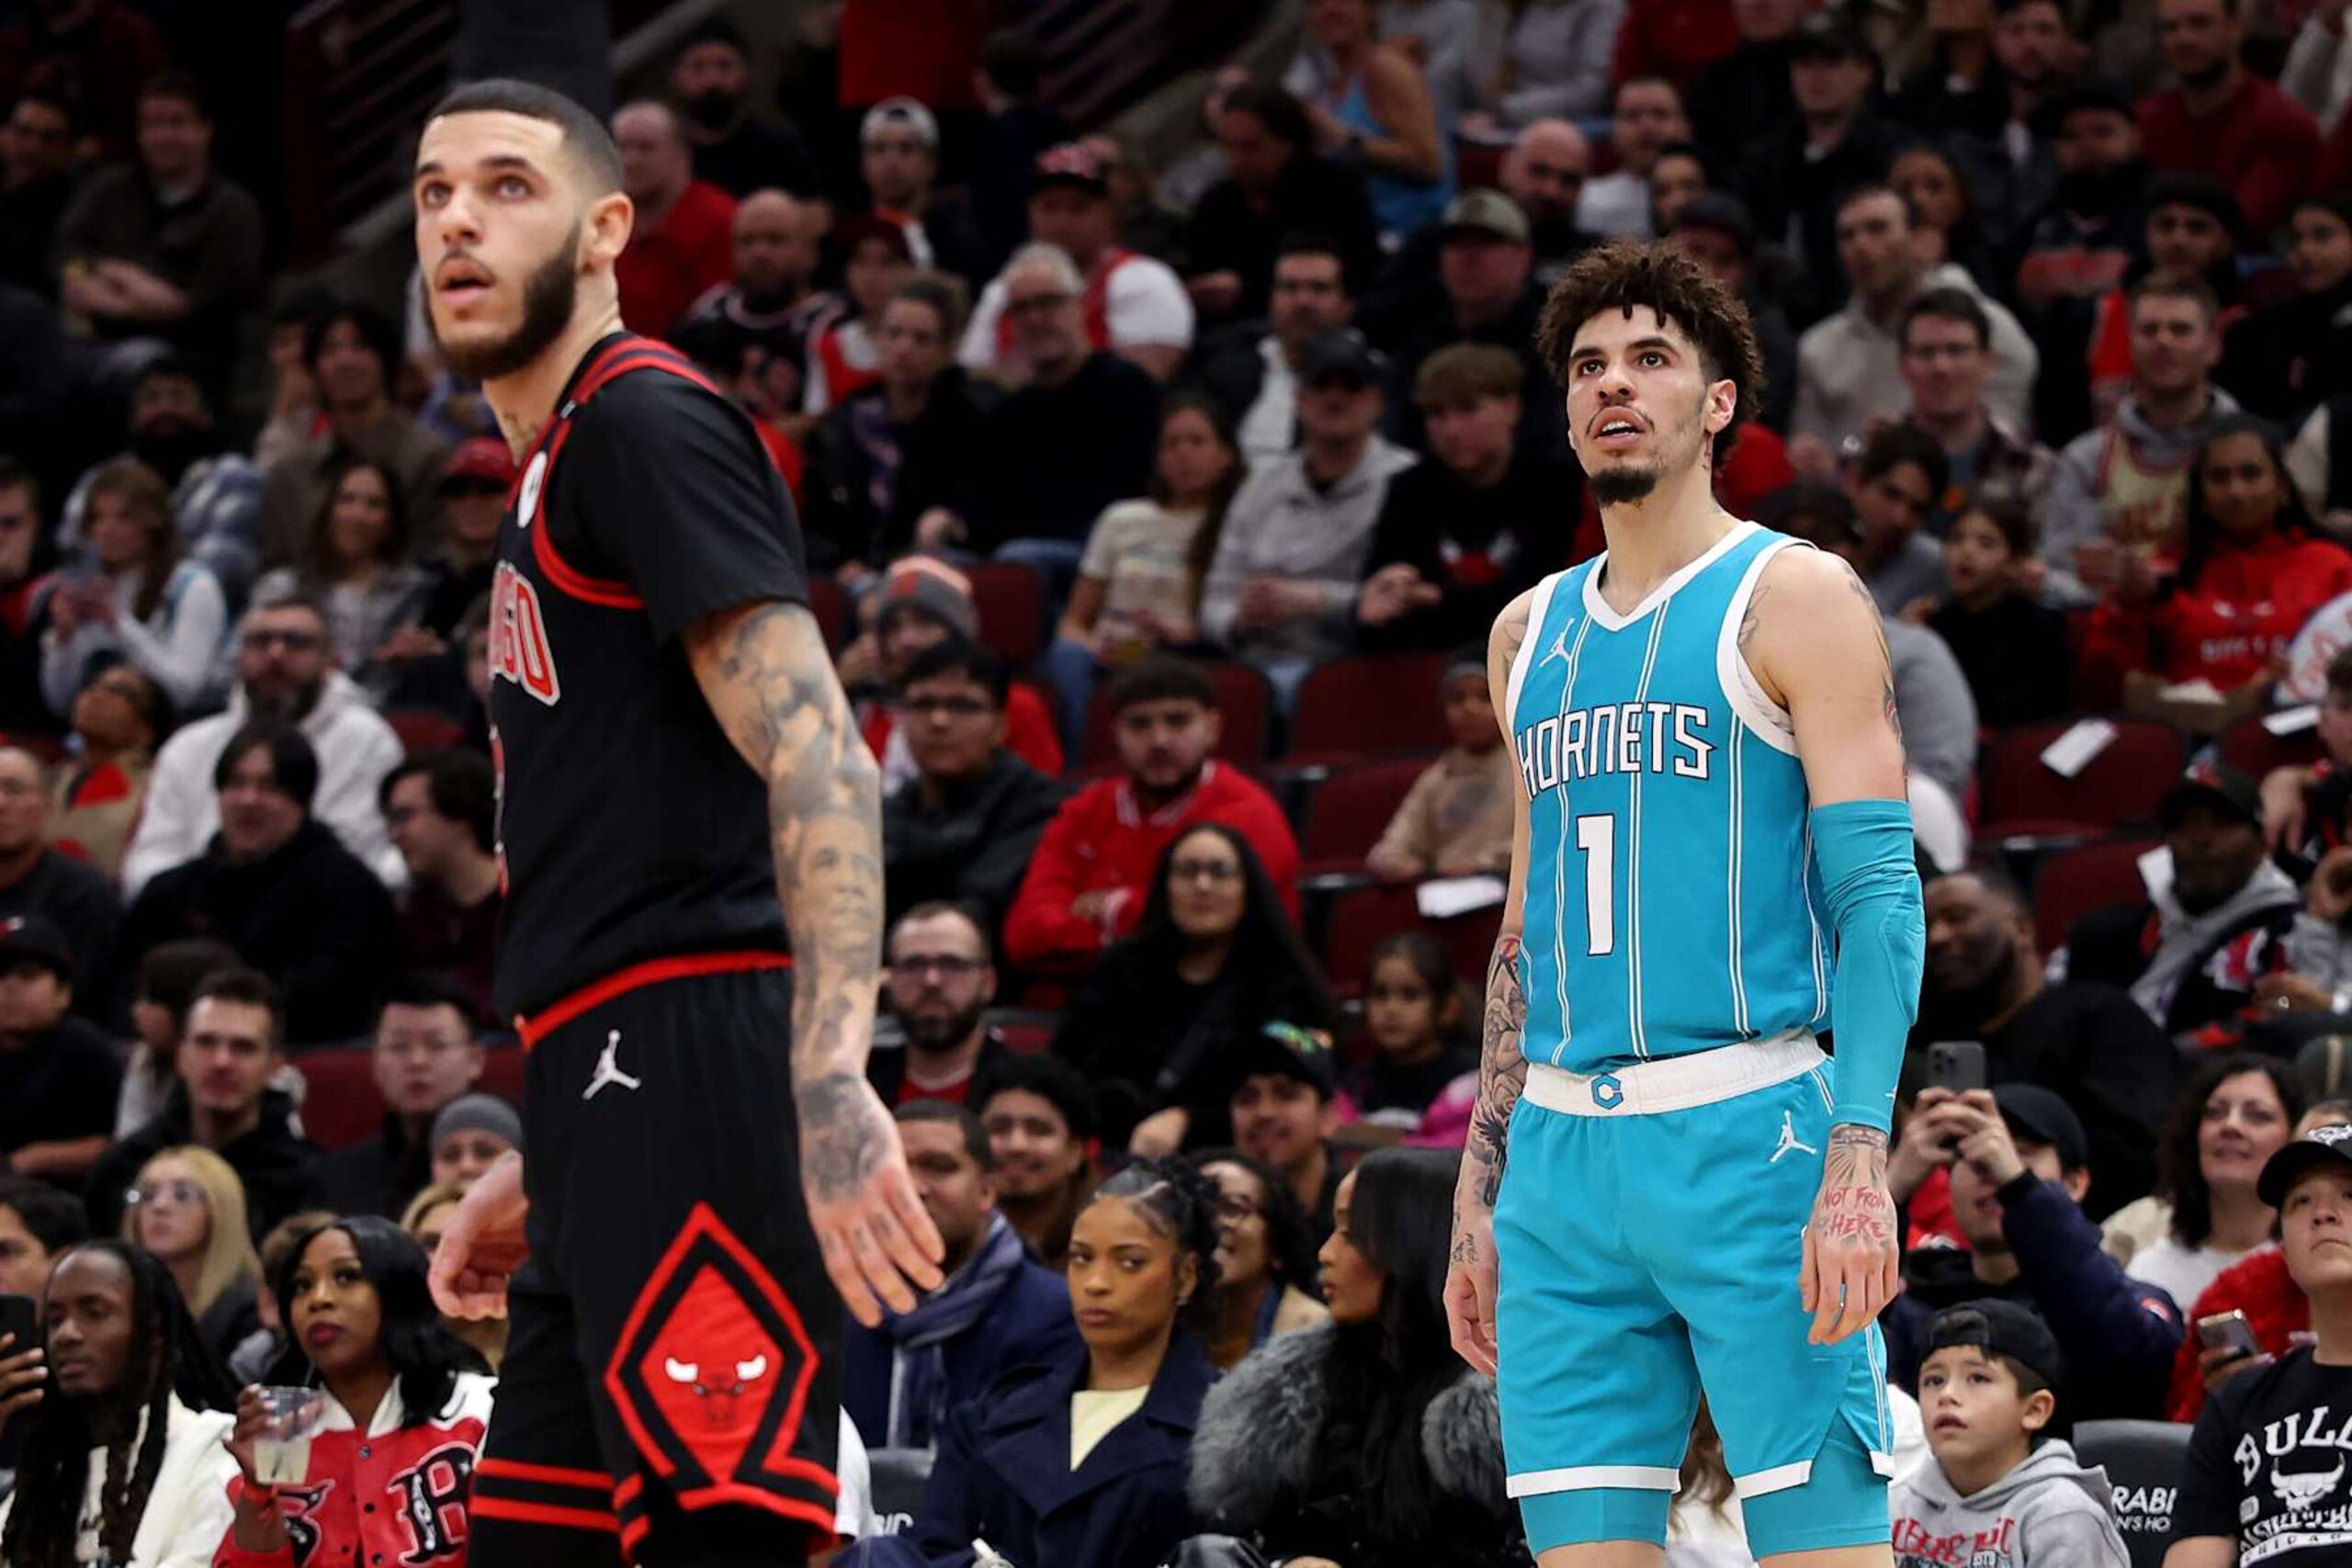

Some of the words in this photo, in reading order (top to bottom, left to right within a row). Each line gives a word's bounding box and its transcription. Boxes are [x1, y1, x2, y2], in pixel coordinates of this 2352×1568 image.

[1517, 702, 1717, 803] HORNETS
[1576, 813, 1614, 956] 1
[1823, 1186, 1849, 1210] NOT
[1829, 1213, 1885, 1242] HERE
